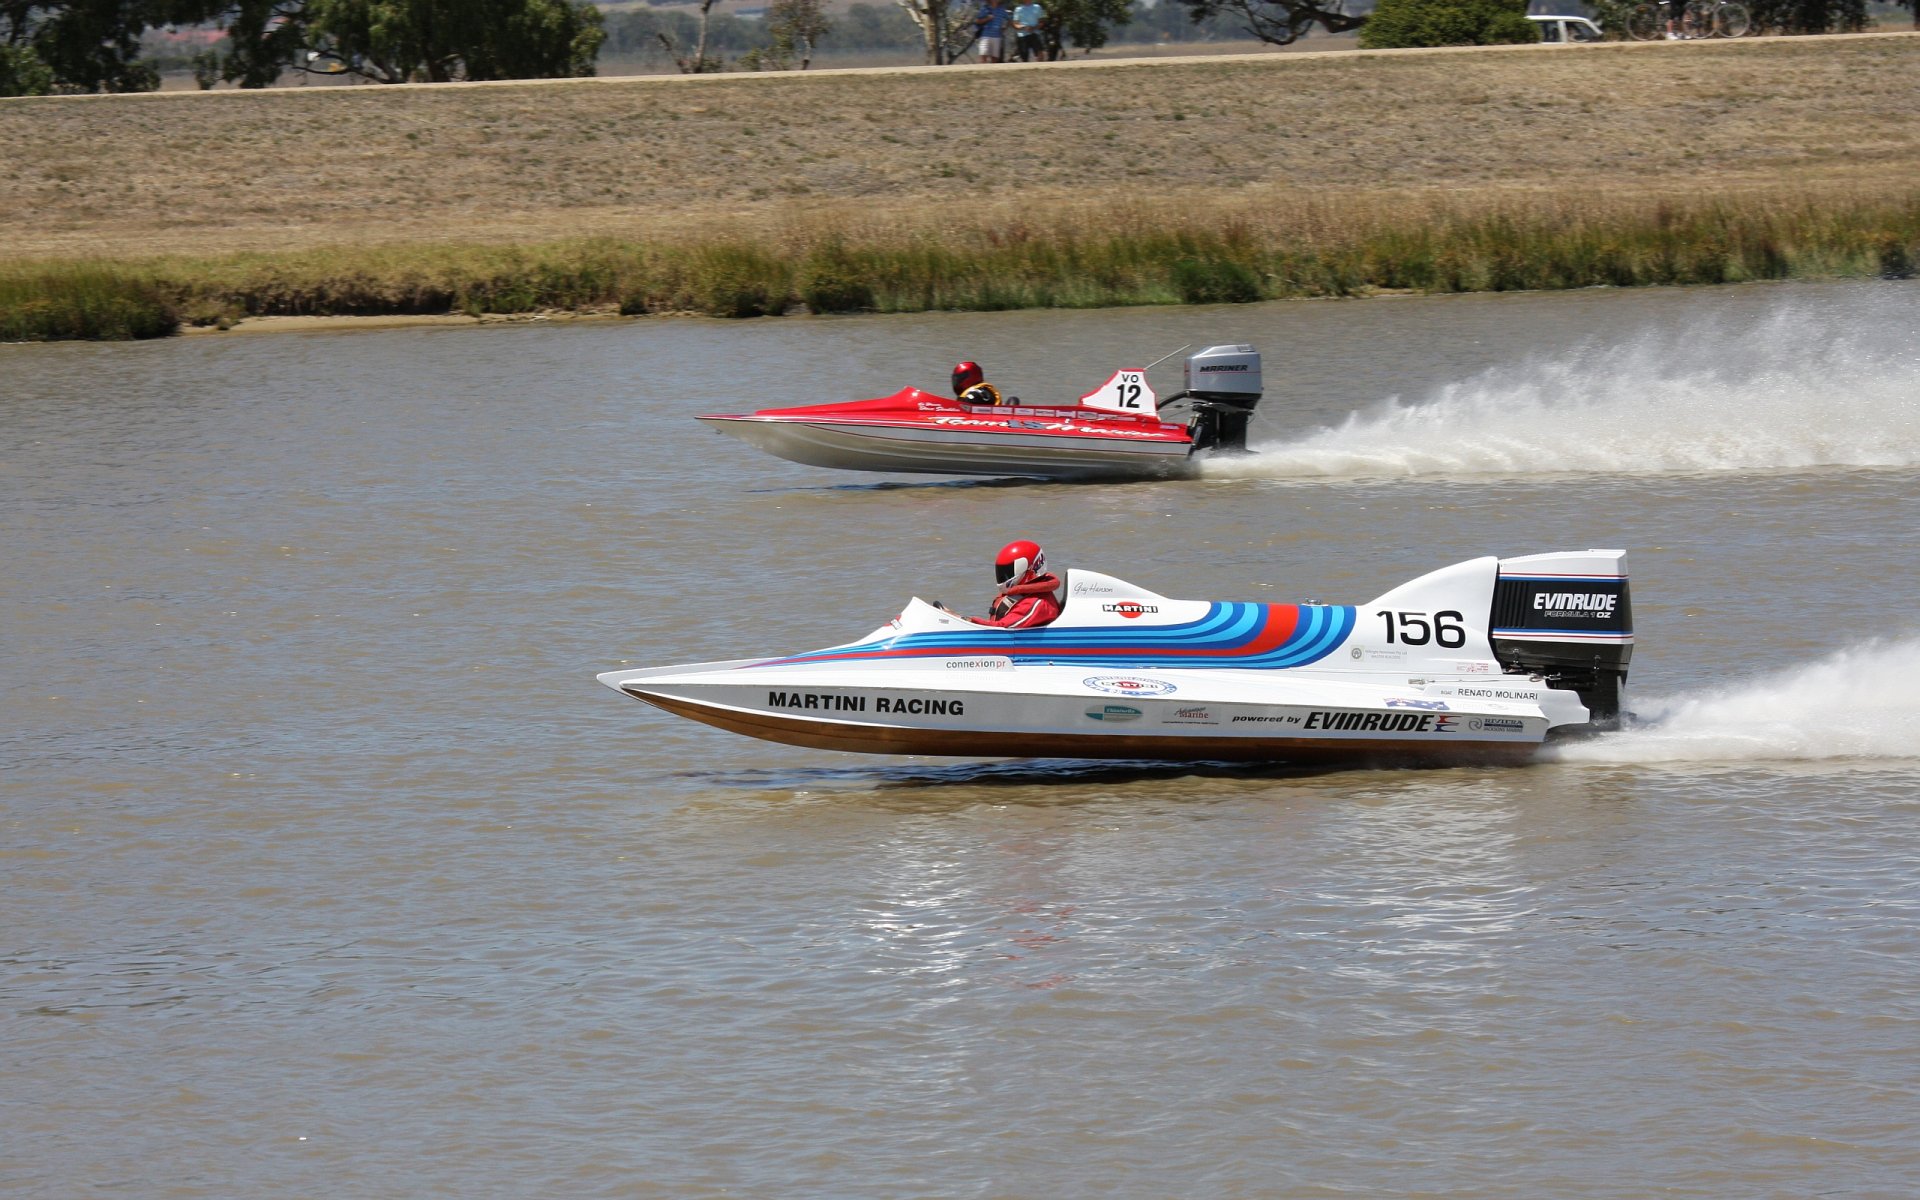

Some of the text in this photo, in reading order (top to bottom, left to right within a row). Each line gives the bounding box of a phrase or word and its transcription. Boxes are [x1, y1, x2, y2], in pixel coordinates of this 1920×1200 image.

[1199, 364, 1248, 372] MARINER
[1121, 374, 1139, 383] VO
[1117, 384, 1141, 409] 12
[1103, 604, 1158, 613] MARTINI
[1533, 593, 1617, 611] EVINRUDE
[1544, 610, 1589, 618] FORMULA
[1376, 610, 1466, 649] 156
[1457, 688, 1493, 698] RENATO
[1495, 690, 1538, 700] MOLINARI
[768, 691, 964, 716] MARTINI RACING
[1231, 711, 1434, 732] powered by EVINRUDE
